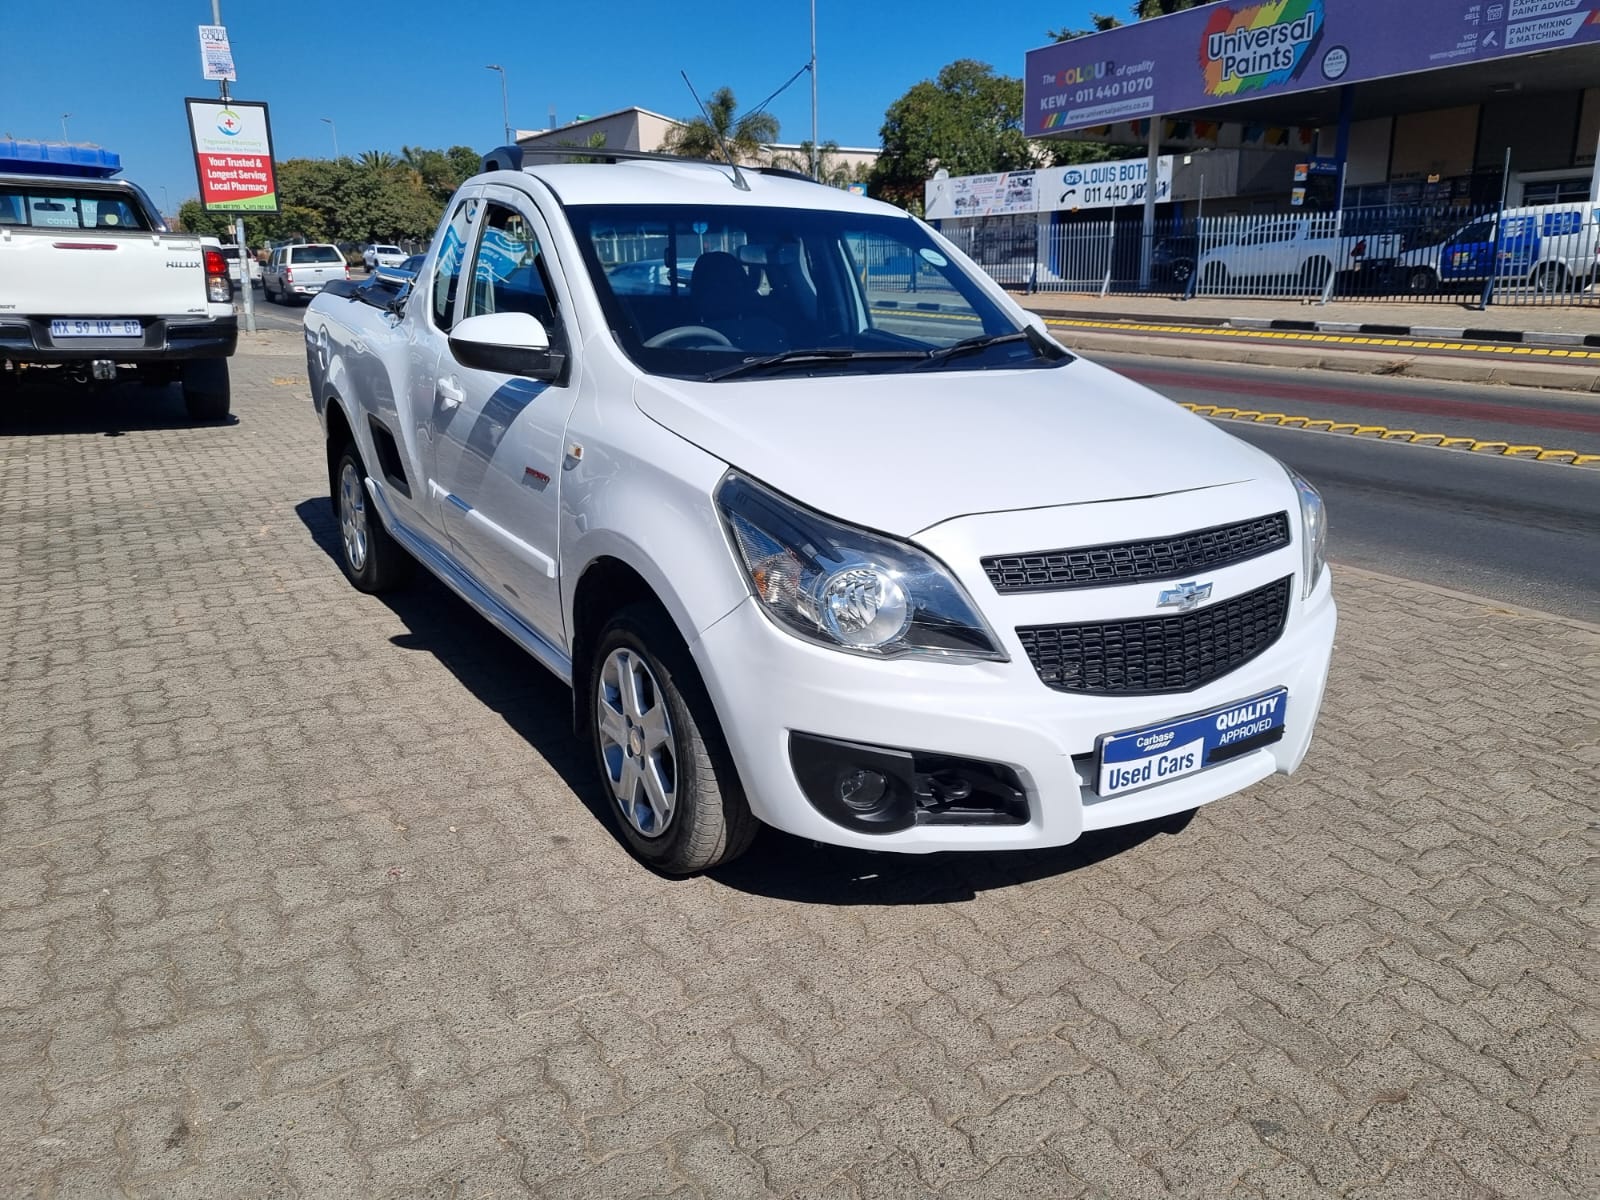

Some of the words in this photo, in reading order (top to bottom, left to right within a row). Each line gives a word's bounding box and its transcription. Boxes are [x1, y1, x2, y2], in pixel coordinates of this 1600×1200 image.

[1464, 12, 1480, 20] SELL
[1512, 5, 1539, 16] PAINT
[1541, 0, 1576, 11] ADVICE
[1510, 24, 1537, 35] PAINT
[1539, 18, 1572, 31] MIXING
[1208, 13, 1314, 58] Universal
[1463, 33, 1478, 41] YOU
[1516, 29, 1565, 43] MATCHING
[1223, 46, 1292, 79] Paints
[1043, 73, 1056, 85] The
[1056, 61, 1116, 88] COLOUR
[1116, 65, 1126, 77] of
[1126, 60, 1155, 77] quality
[1040, 94, 1067, 110] KEW
[1075, 88, 1094, 103] 011
[1096, 83, 1120, 99] 440
[1122, 76, 1153, 95] 1070
[208, 156, 226, 167] Your
[226, 157, 255, 168] Trusted
[256, 158, 263, 168] &
[207, 169, 237, 180] Longest
[238, 170, 267, 182] Serving
[1083, 166, 1117, 185] LOUIS
[209, 181, 231, 191] Local
[231, 181, 268, 193] Pharmacy
[1084, 187, 1101, 203] 011
[1104, 185, 1128, 200] 440
[75, 321, 90, 334] 59
[124, 321, 139, 334] GP
[1215, 697, 1279, 730] QUALITY
[1136, 731, 1175, 748] Carbase
[1219, 717, 1272, 746] APPROVED
[1109, 759, 1151, 790] Used
[1157, 752, 1194, 777] Cars
